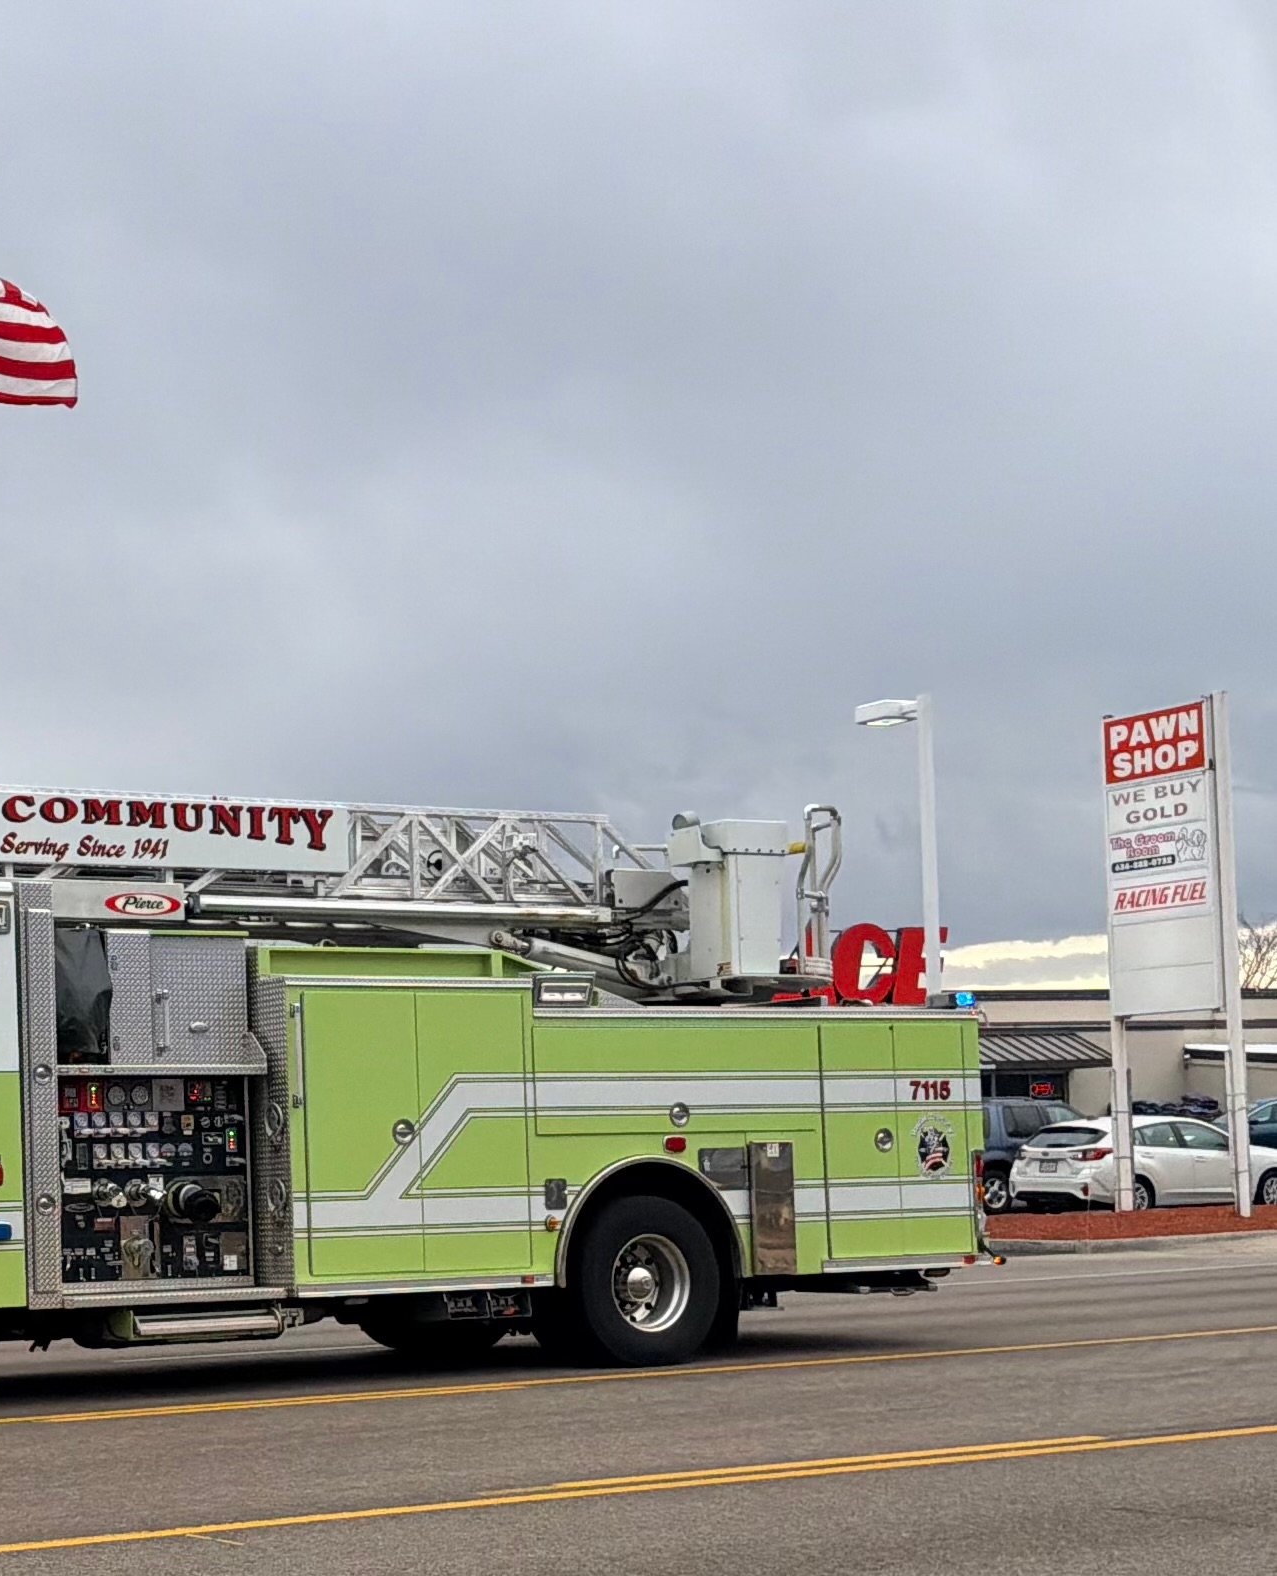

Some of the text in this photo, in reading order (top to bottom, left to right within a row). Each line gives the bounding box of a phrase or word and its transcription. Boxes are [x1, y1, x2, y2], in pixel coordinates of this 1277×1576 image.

[1109, 709, 1199, 751] PAWN
[1112, 739, 1199, 778] SHOP
[1112, 779, 1202, 806] WE BUY
[1, 795, 334, 851] COMMUNITY
[1125, 802, 1188, 824] GOLD
[0, 832, 169, 862] Serving Since 1941
[1110, 831, 1176, 850] The Groom
[122, 896, 165, 913] Pierce
[1114, 881, 1207, 911] RACING FUEL
[910, 1080, 951, 1100] 7115
